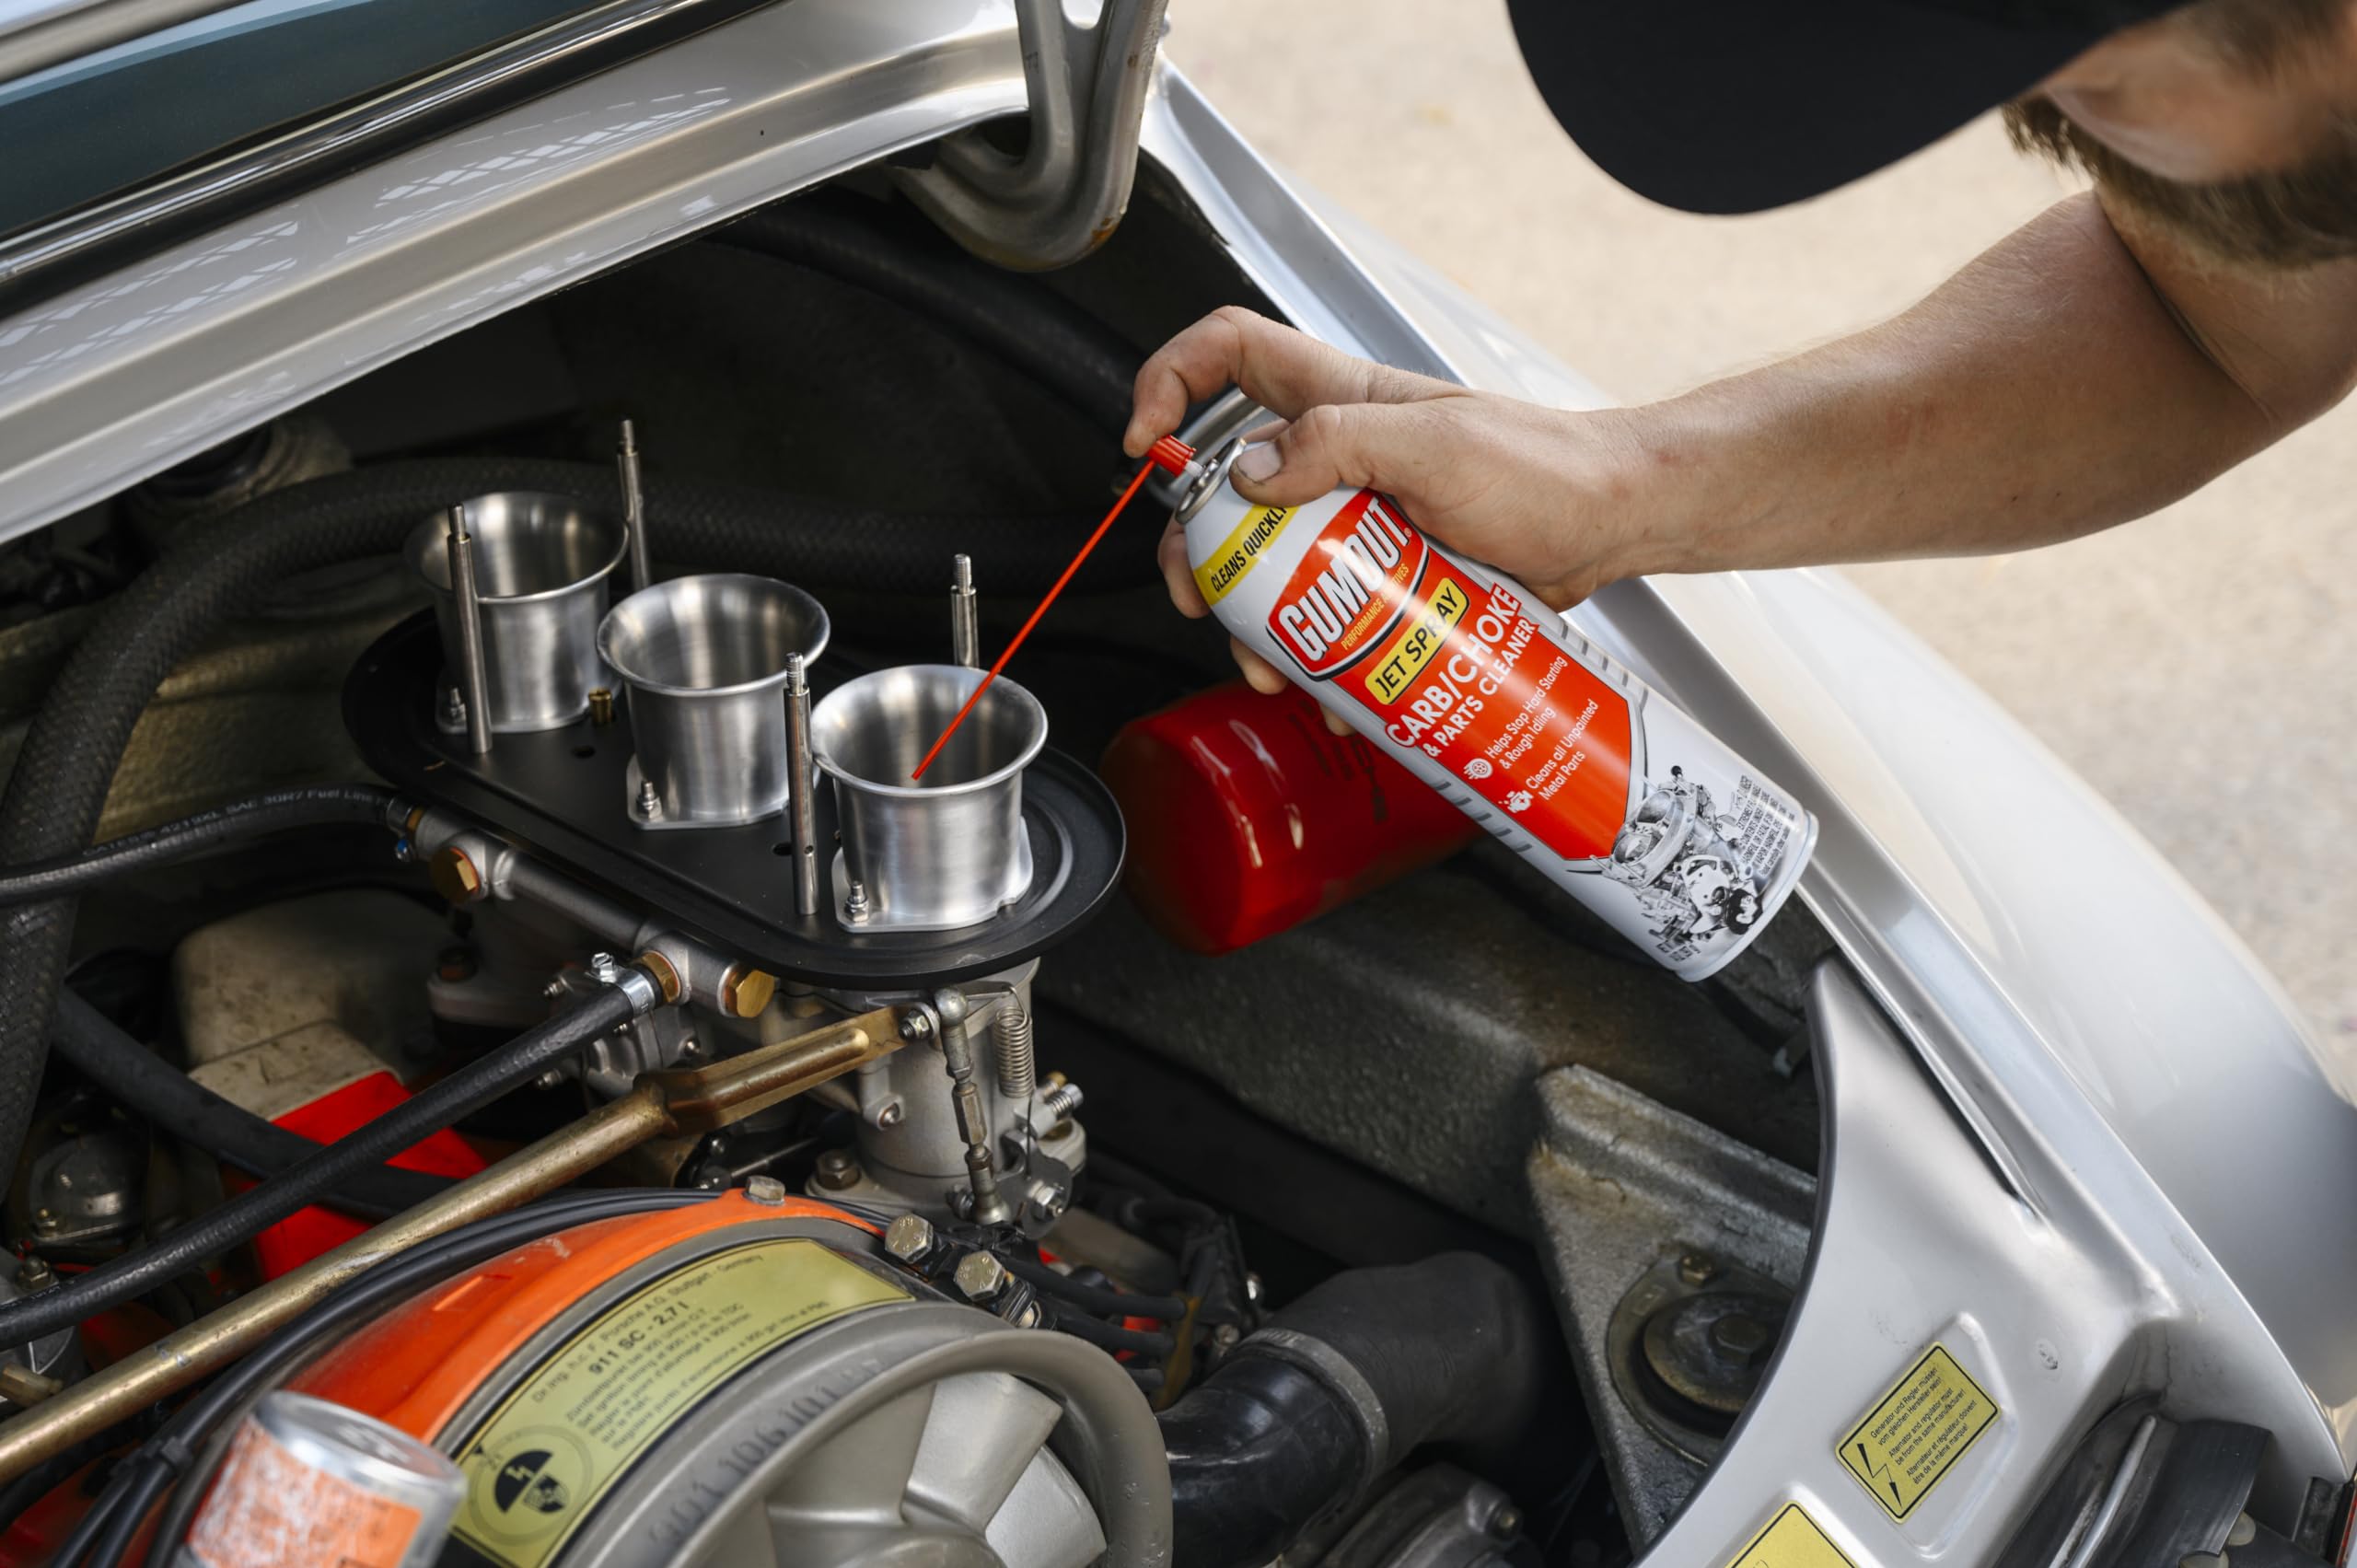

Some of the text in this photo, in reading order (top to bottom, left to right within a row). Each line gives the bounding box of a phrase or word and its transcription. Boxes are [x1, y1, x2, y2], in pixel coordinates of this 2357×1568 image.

[1211, 506, 1287, 593] CLEANS QUICKLY
[1279, 496, 1410, 662] GUMOUT
[1341, 597, 1385, 650] PERFORMANCE
[1375, 587, 1457, 698] JET SPRAY
[1387, 585, 1520, 747] CARB/CHOKE
[1422, 618, 1537, 757] & PARTS CLEANER
[1485, 656, 1569, 759] Helps Stop Hard Starting
[1499, 706, 1557, 770] & Rough Idling
[1526, 698, 1598, 789] Cleans all Unpainted
[1538, 750, 1586, 801] Metal Parts
[308, 787, 340, 798] Fuel
[344, 789, 373, 802] Line
[588, 1350, 619, 1374] 911
[618, 1330, 645, 1350] SC
[653, 1306, 678, 1326] 2,7
[1870, 1412, 1895, 1438] Generator
[1894, 1401, 1905, 1414] und
[1902, 1386, 1920, 1404] Regler
[1878, 1433, 1889, 1446] vom
[1888, 1412, 1910, 1435] gleichen
[1907, 1388, 1931, 1414] Hersteller
[1888, 1388, 1954, 1458] Alternator and regulator must
[1895, 1456, 1905, 1466] be
[1901, 1445, 1915, 1458] from
[1912, 1435, 1923, 1446] the
[1922, 1422, 1935, 1437] same
[1906, 1400, 1977, 1477] Alternateur et régulateur doivent
[717, 1426, 788, 1477] 106
[1923, 1465, 1932, 1474] de
[1934, 1444, 1951, 1461] même
